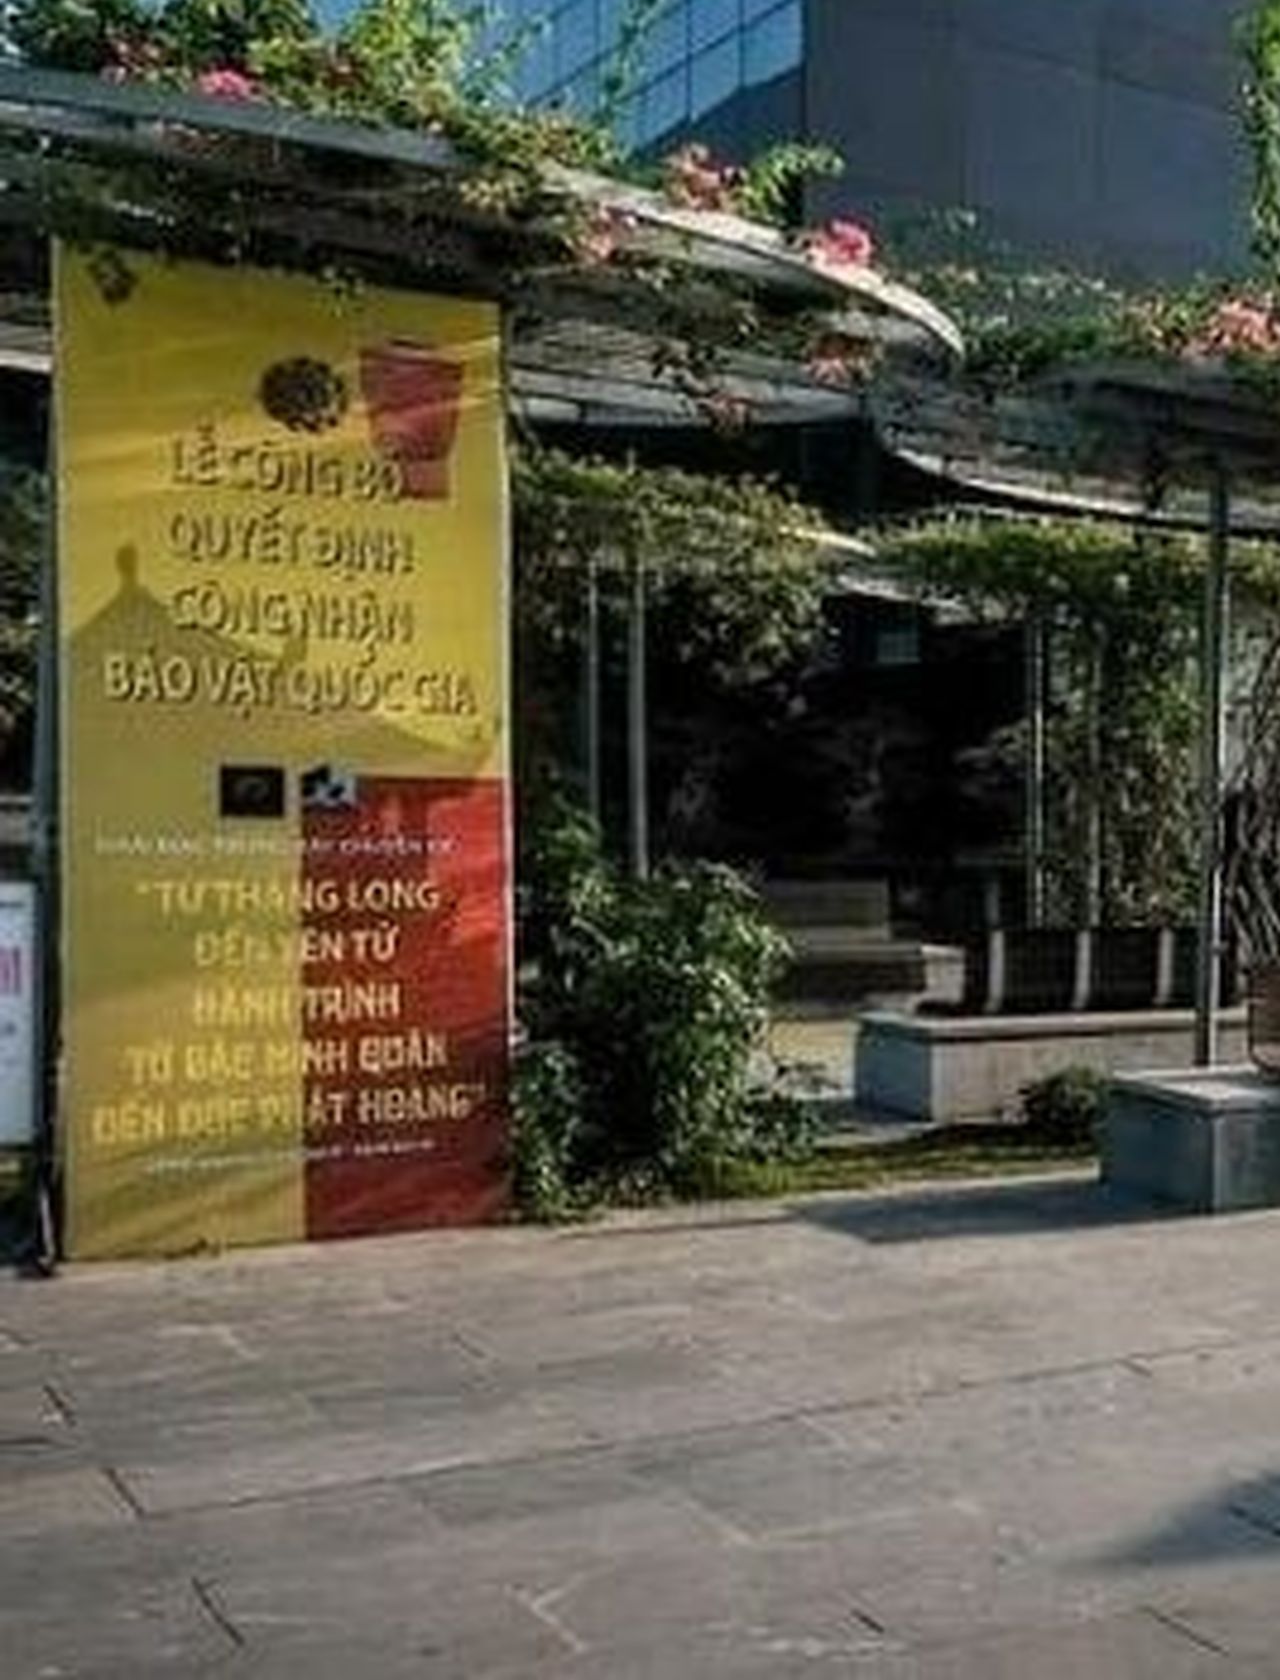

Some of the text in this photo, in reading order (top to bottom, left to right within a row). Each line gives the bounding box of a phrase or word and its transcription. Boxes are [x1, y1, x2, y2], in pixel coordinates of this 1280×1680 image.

[229, 439, 344, 498] CÔNG
[170, 504, 307, 564] QUYẾT
[173, 579, 294, 637] CÔNG
[202, 655, 279, 719] VẬT
[413, 670, 479, 717] GIA
[348, 877, 440, 913] LONG
